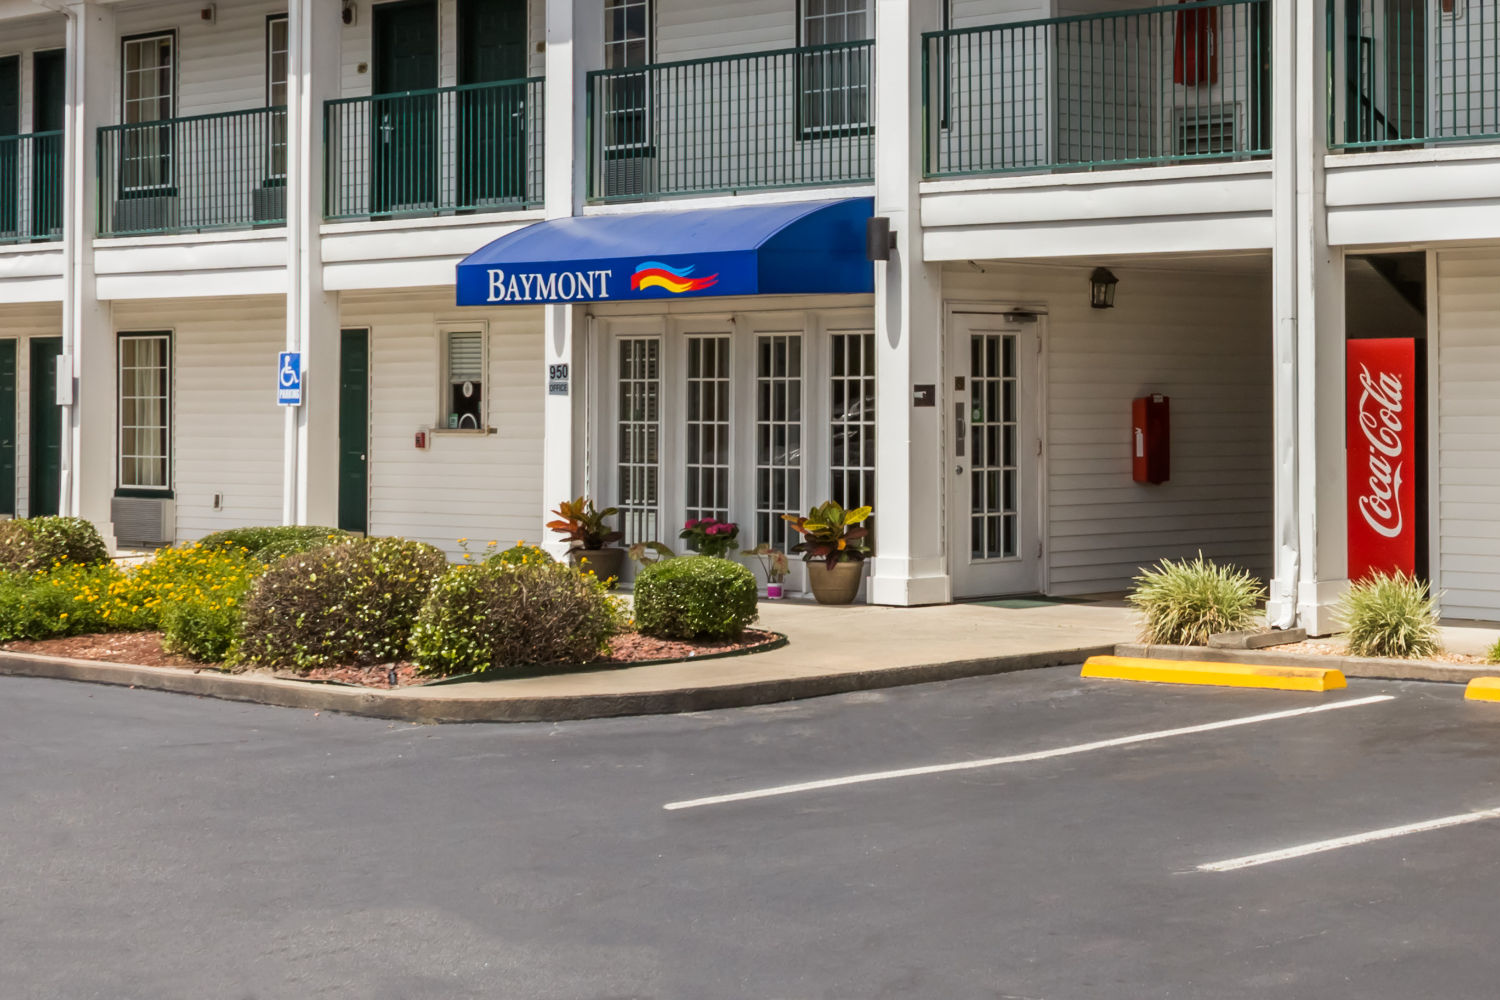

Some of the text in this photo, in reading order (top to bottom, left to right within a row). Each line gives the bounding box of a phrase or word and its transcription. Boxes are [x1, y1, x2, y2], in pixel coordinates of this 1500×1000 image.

[486, 269, 612, 302] BAYMONT
[550, 364, 568, 380] 950
[549, 384, 568, 392] OFFICE
